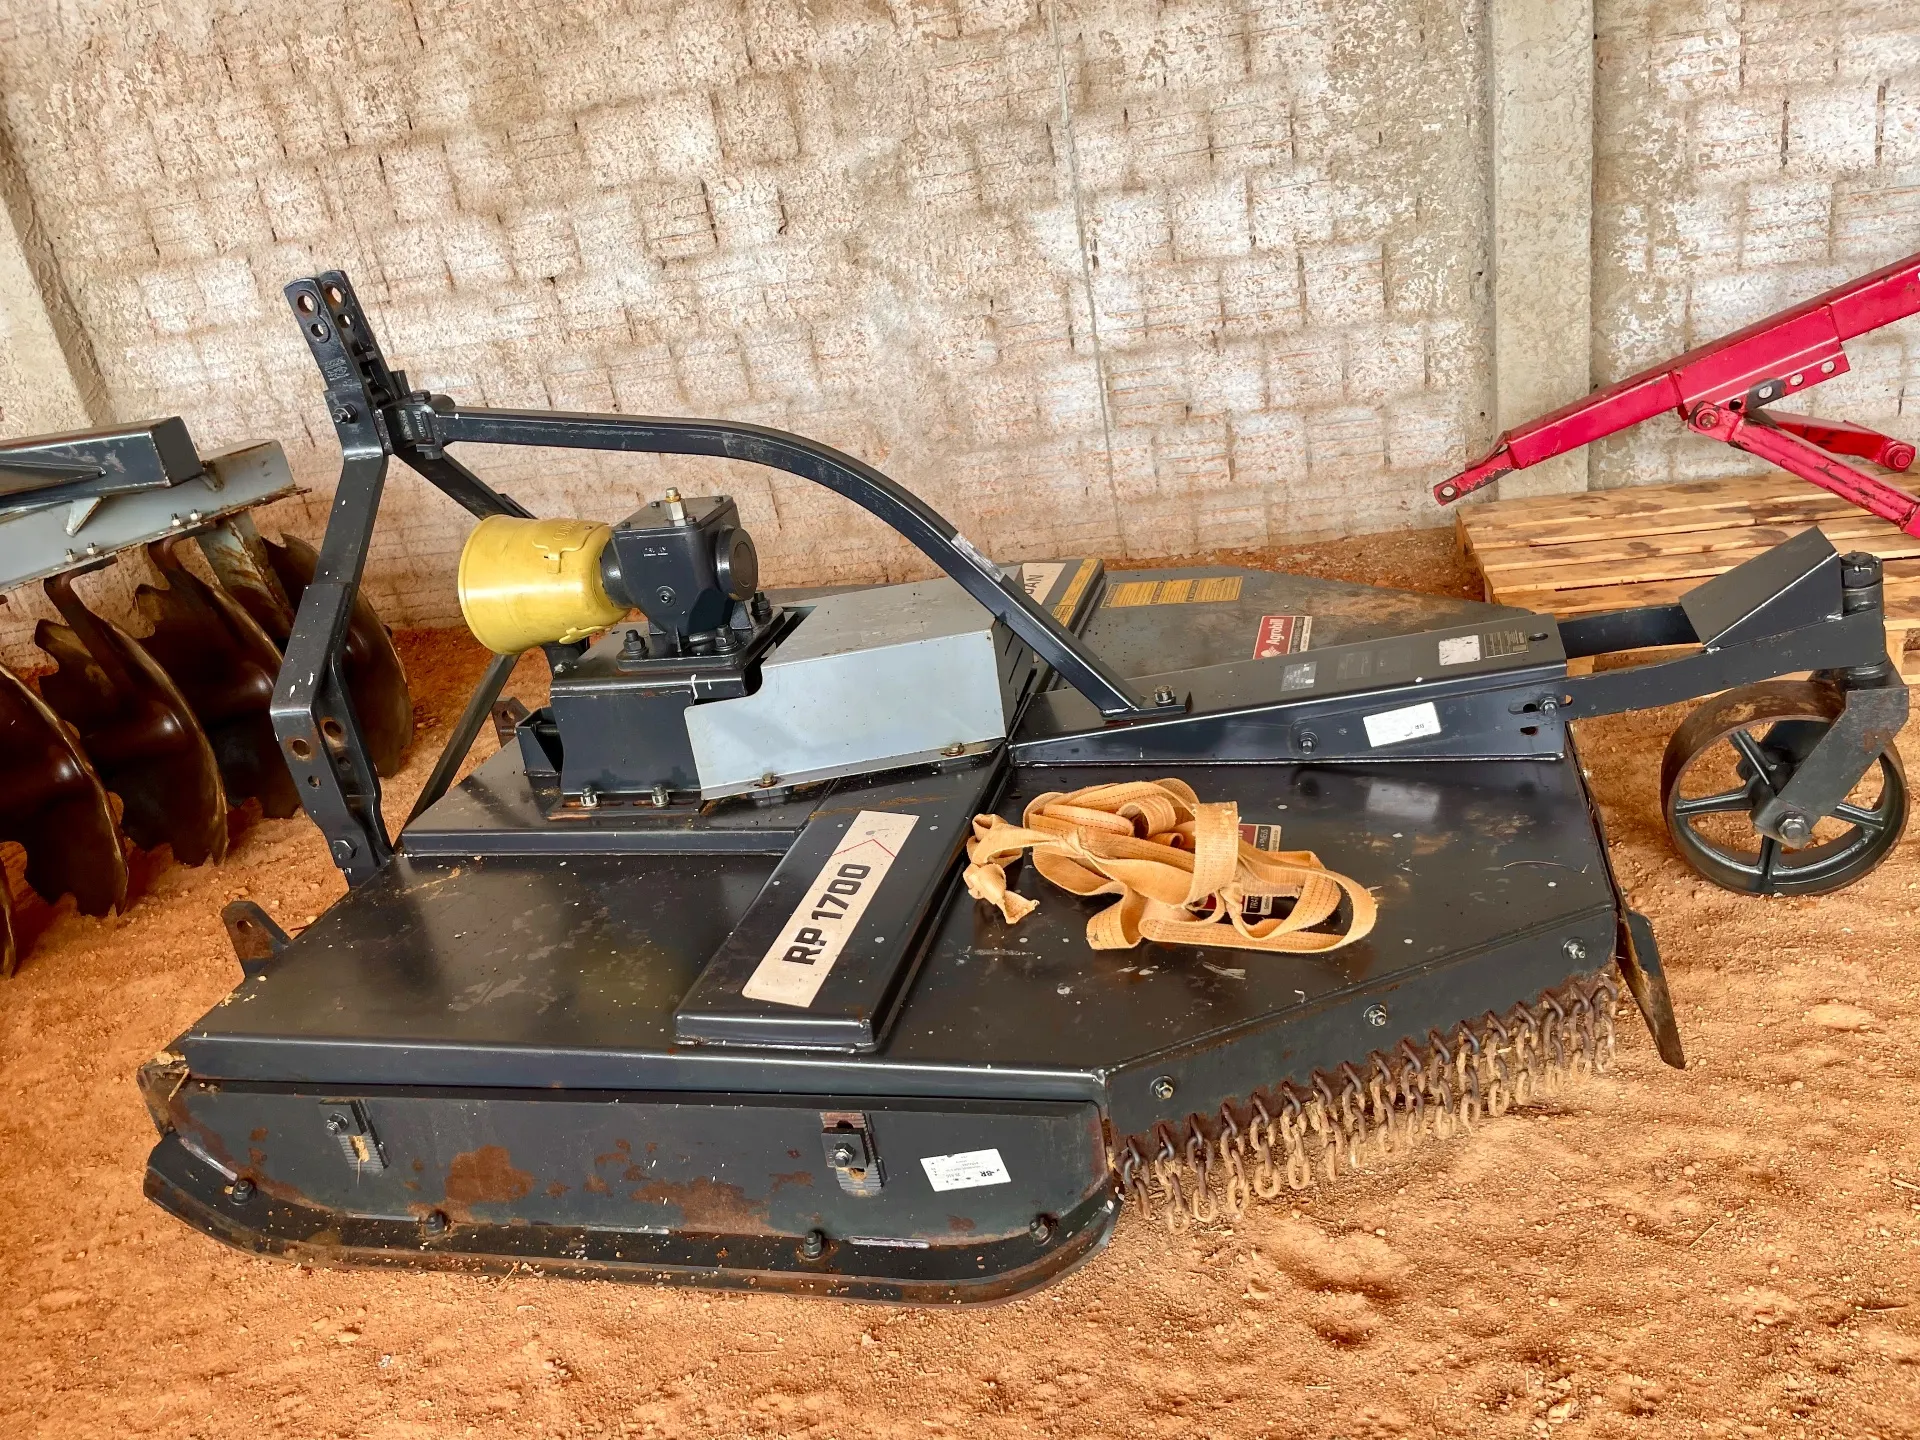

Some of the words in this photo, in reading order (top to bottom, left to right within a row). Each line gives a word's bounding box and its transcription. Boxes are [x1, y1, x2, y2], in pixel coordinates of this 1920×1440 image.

[1265, 618, 1285, 646] Agrobill
[781, 927, 828, 966] RP
[811, 863, 871, 920] 1700
